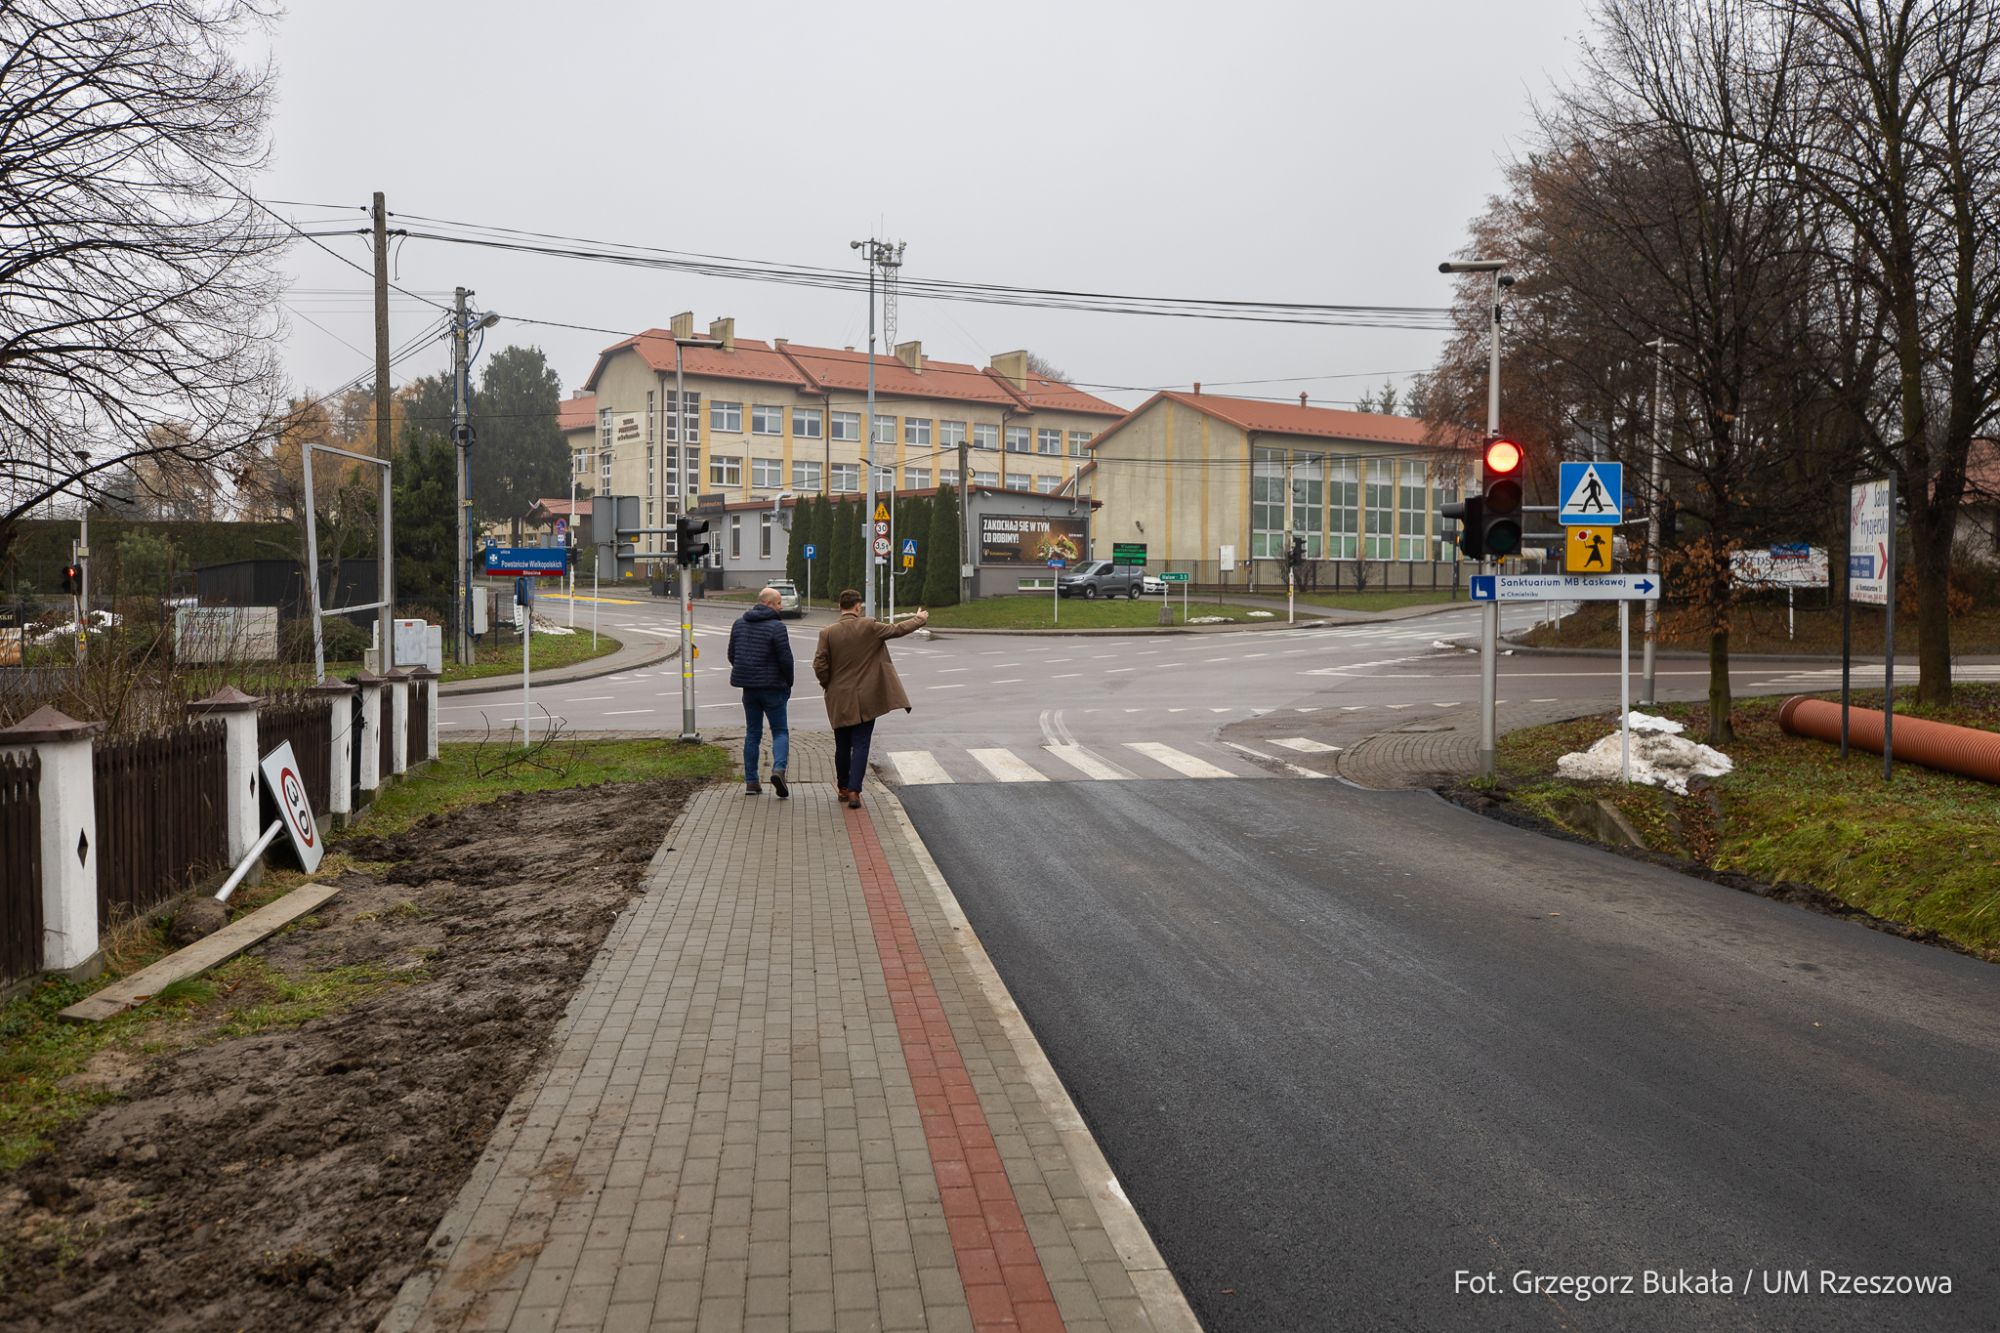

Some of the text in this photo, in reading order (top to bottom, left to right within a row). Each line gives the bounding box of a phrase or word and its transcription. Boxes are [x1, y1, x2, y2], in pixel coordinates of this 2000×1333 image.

[1874, 483, 1889, 507] Salon
[983, 520, 1050, 532] ZAKOCHAJ SIĘ W TYM
[1861, 511, 1889, 543] Fryzjerski
[983, 533, 1019, 544] CO ROBIMY!
[530, 560, 562, 569] Wielkopolskich
[1501, 577, 1626, 588] Sanktuarium MB Łaskawej
[286, 780, 309, 836] 30
